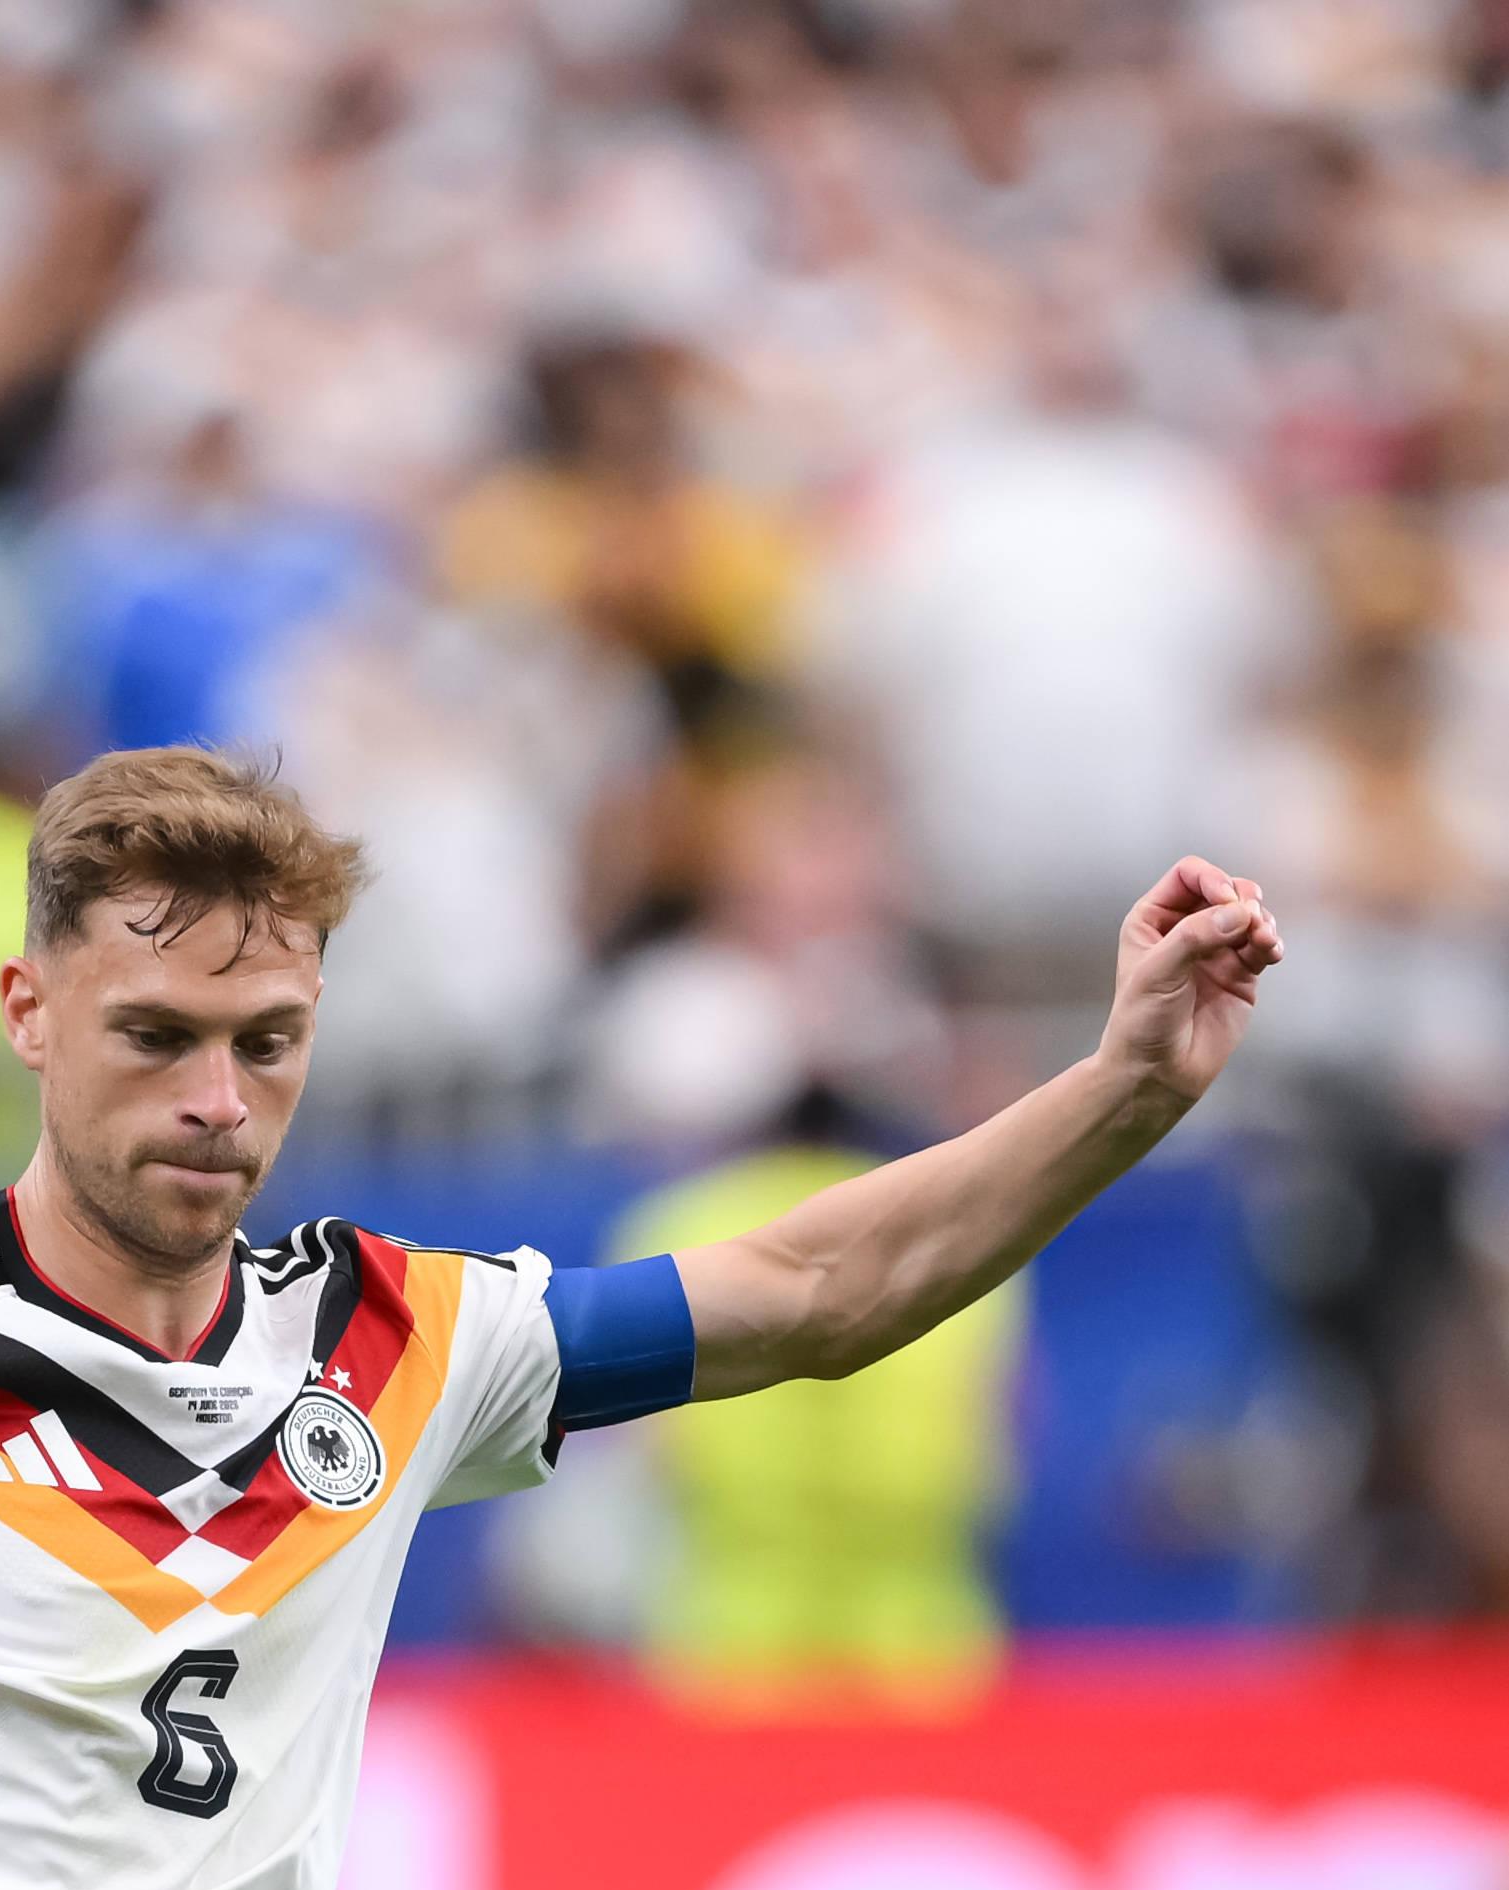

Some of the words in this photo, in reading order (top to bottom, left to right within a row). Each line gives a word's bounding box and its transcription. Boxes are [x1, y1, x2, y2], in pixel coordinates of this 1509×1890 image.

[199, 1400, 217, 1410] JUNE
[195, 1413, 233, 1423] HOUSTON
[294, 1406, 343, 1431] DEUTSCHER
[137, 1649, 239, 1819] 6
